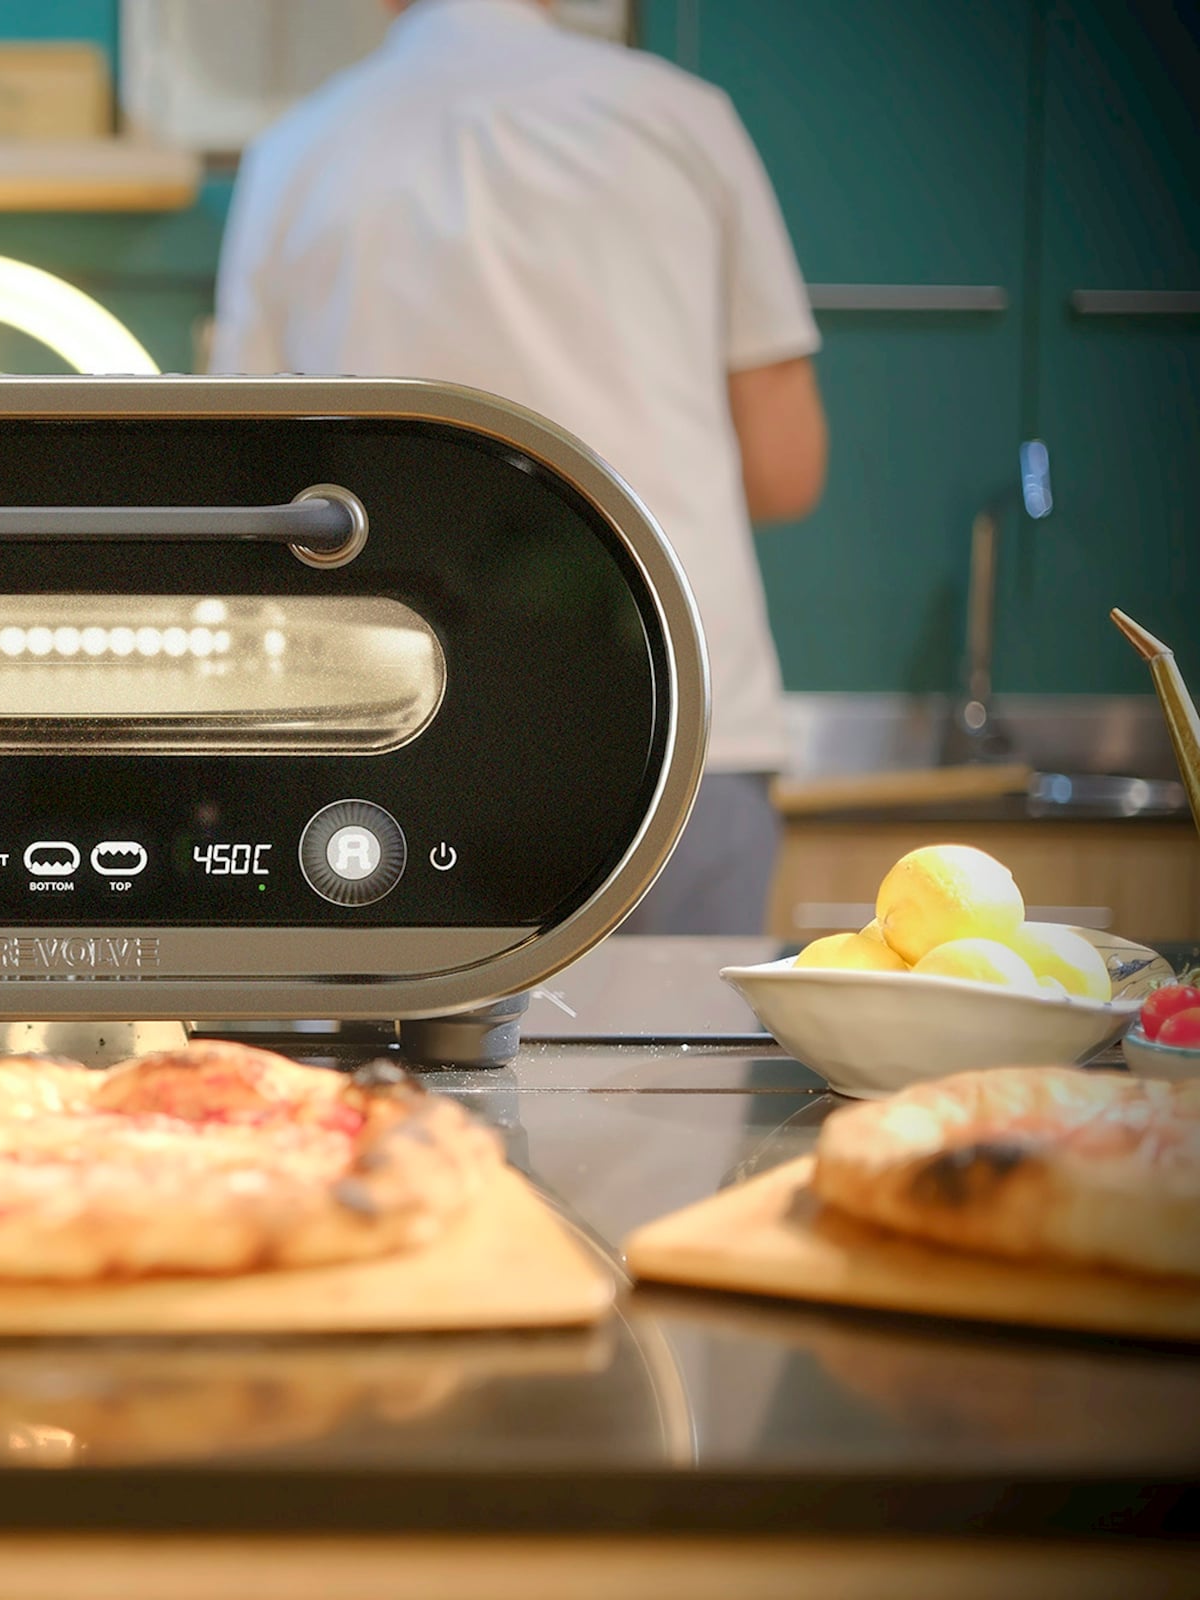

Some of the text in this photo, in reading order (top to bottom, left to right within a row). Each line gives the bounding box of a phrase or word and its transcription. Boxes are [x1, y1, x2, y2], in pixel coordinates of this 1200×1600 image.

[193, 844, 273, 875] 450C
[29, 881, 75, 891] BOTTOM
[109, 881, 132, 891] TOP
